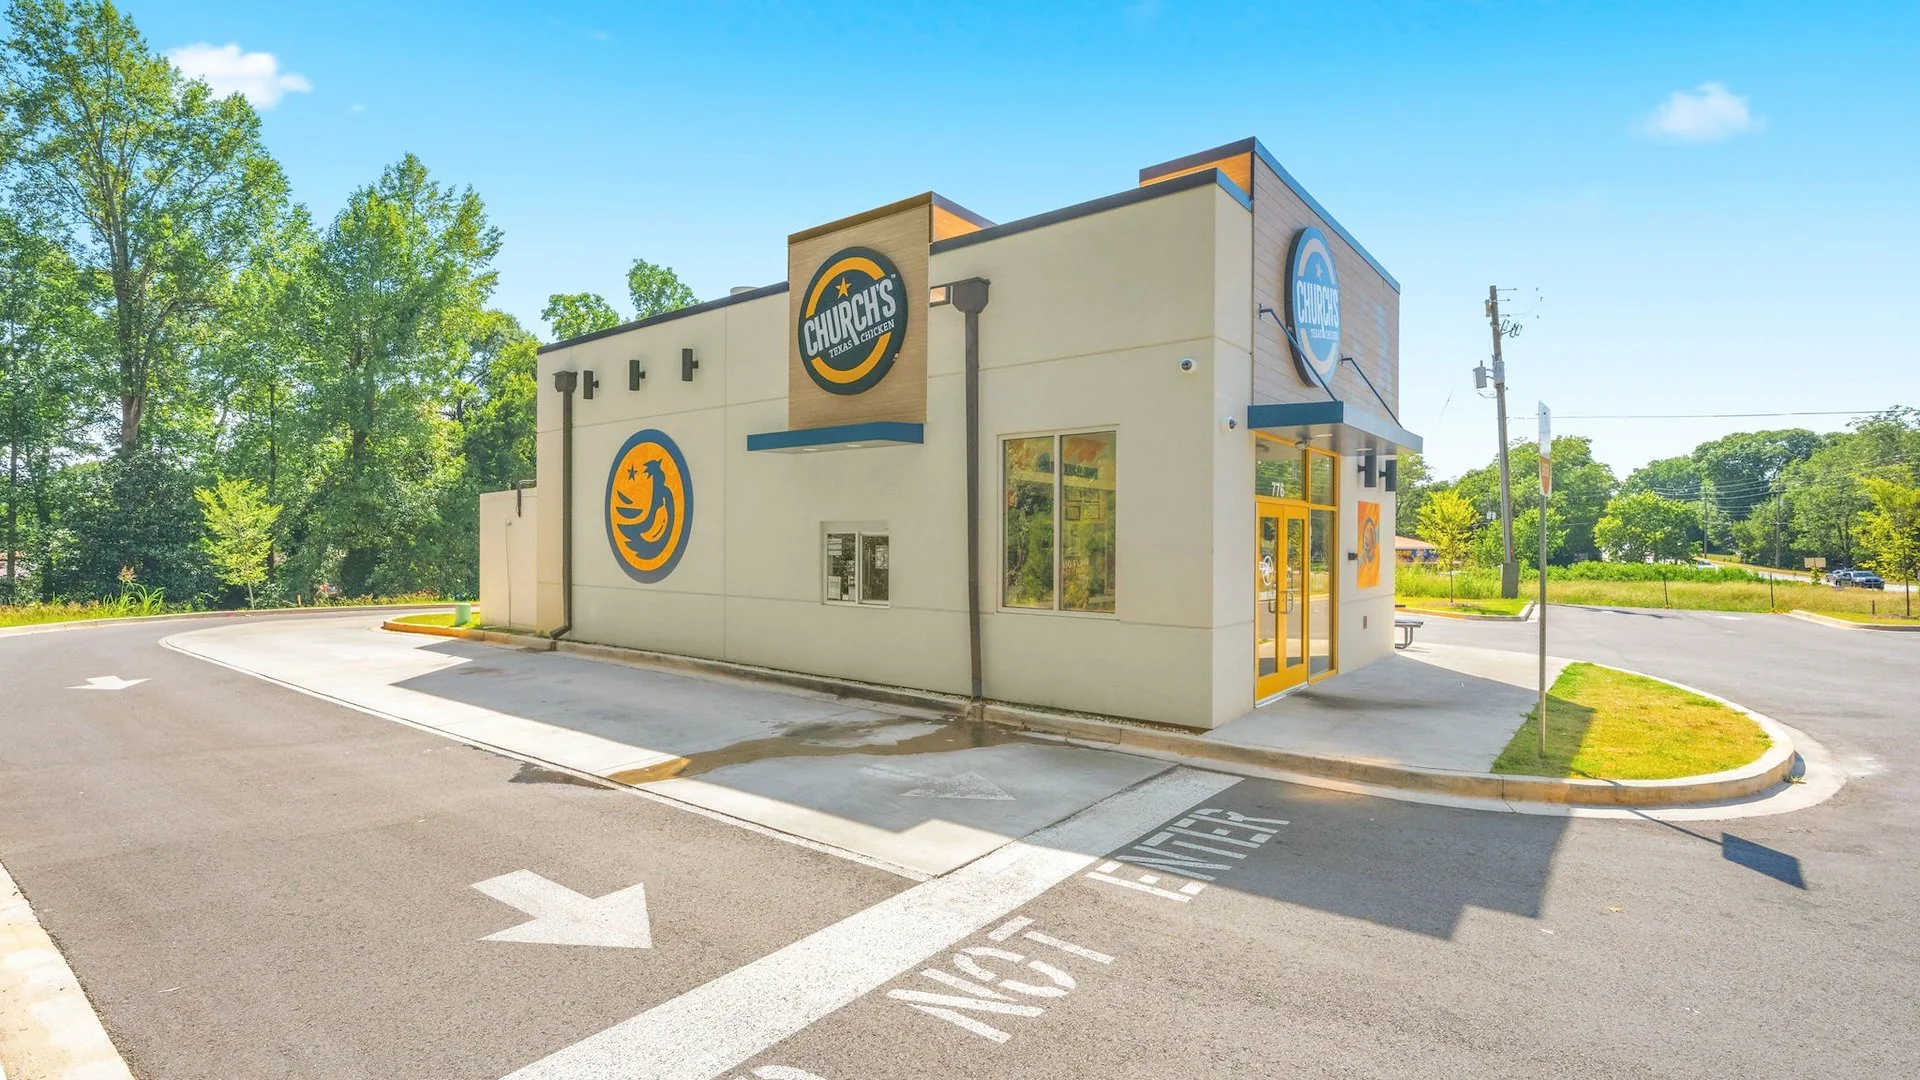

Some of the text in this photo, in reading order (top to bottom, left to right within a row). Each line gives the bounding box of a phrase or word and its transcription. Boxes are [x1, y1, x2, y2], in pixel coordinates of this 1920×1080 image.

[804, 279, 896, 356] CHURCH'S
[829, 319, 895, 358] TEXAS CHICKEN
[1271, 481, 1285, 497] 776
[887, 808, 1290, 1043] NOT ENTER
